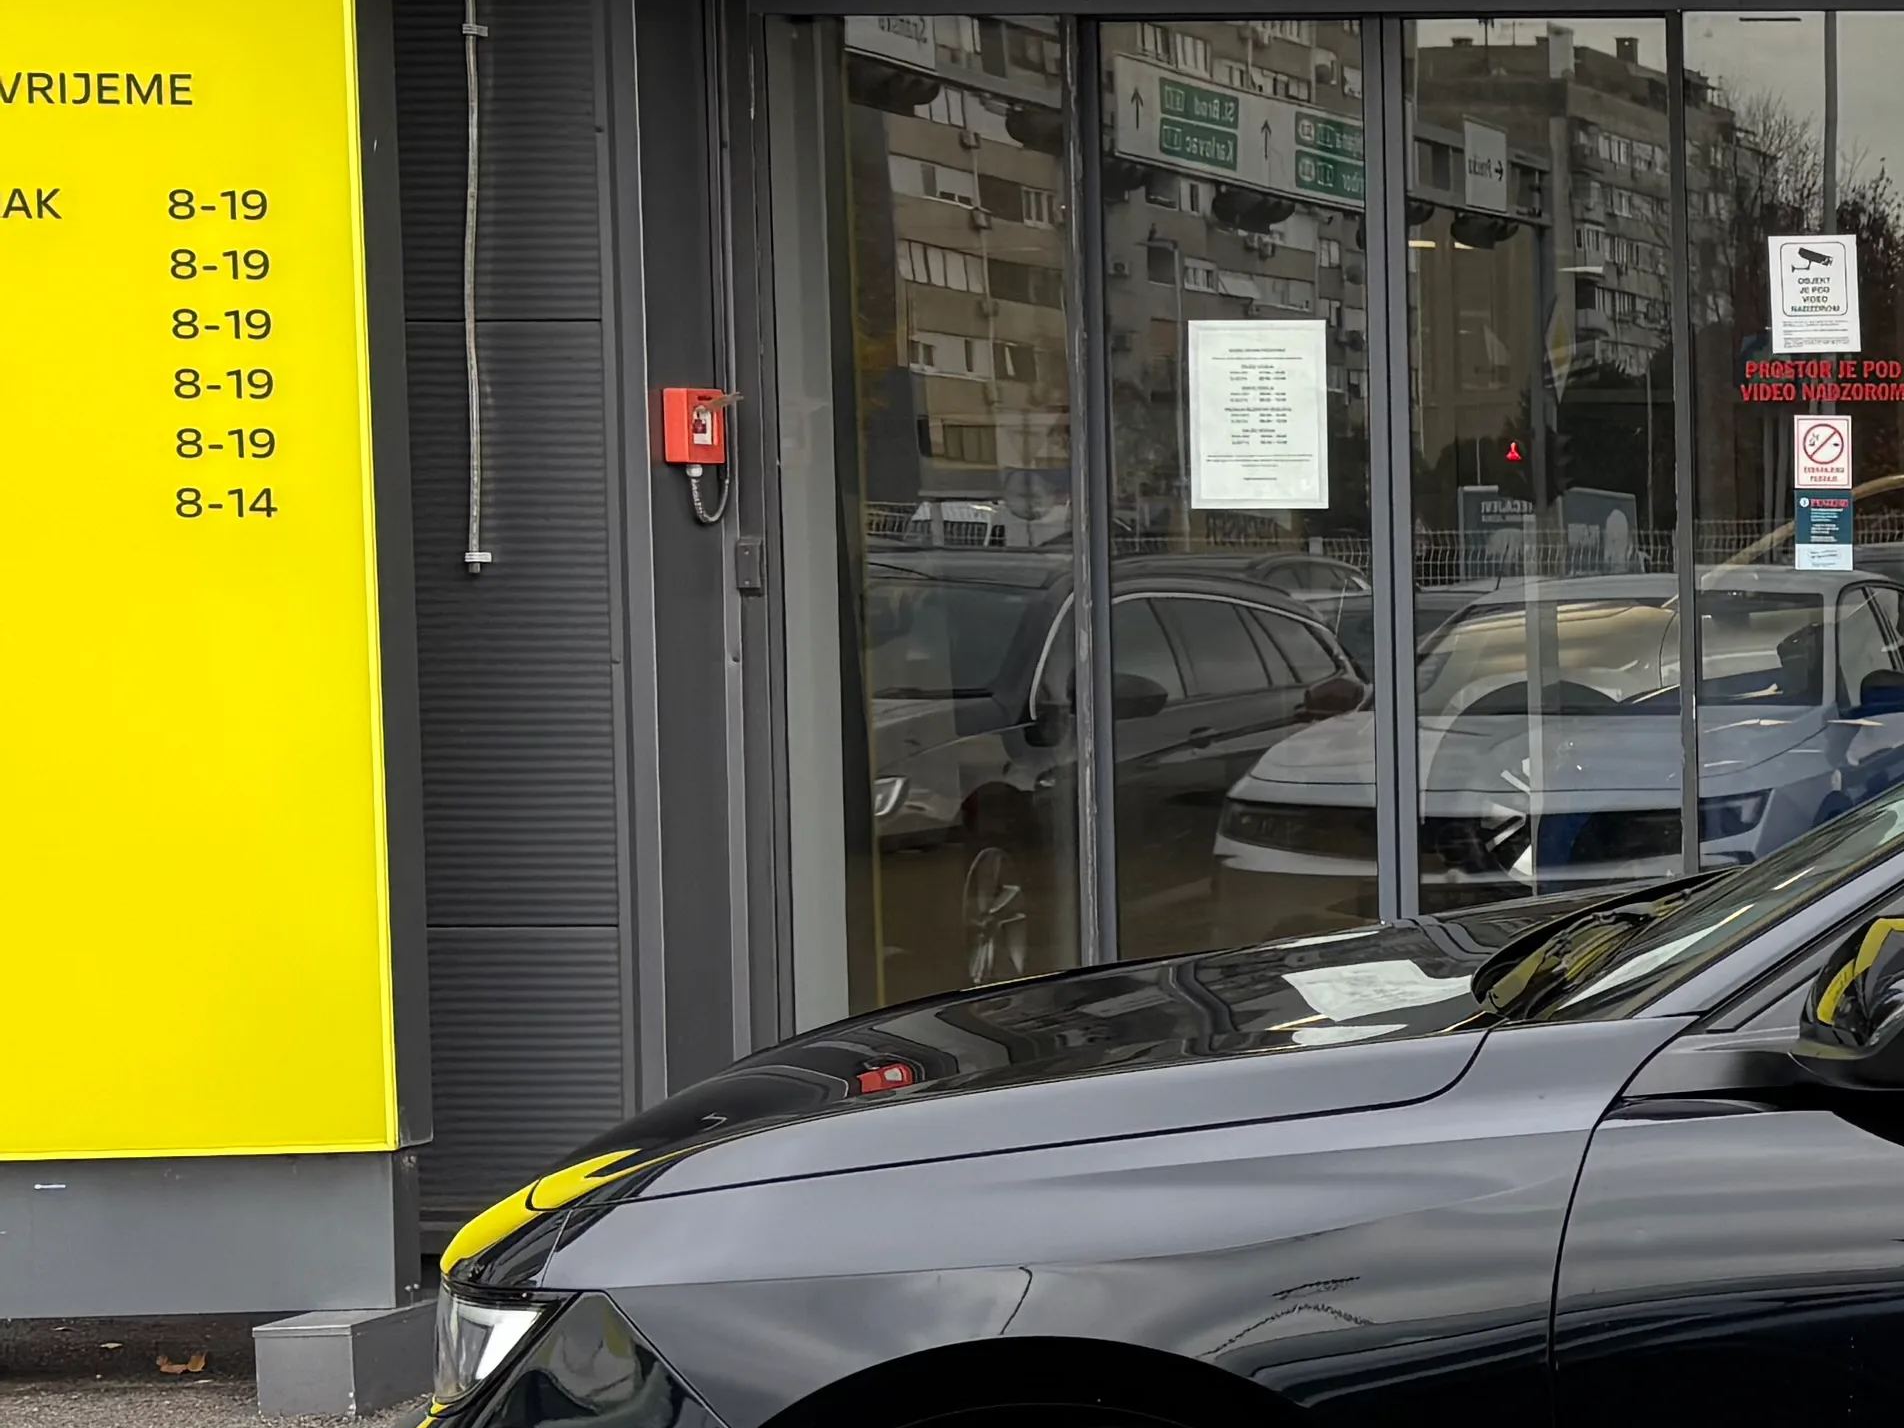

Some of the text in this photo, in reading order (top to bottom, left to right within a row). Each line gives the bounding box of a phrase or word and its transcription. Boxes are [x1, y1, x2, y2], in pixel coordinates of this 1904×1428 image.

[0, 72, 193, 105] VRIJEME
[1745, 360, 1903, 379] PROSTOR JE POD
[1740, 382, 1797, 401] VIDEO
